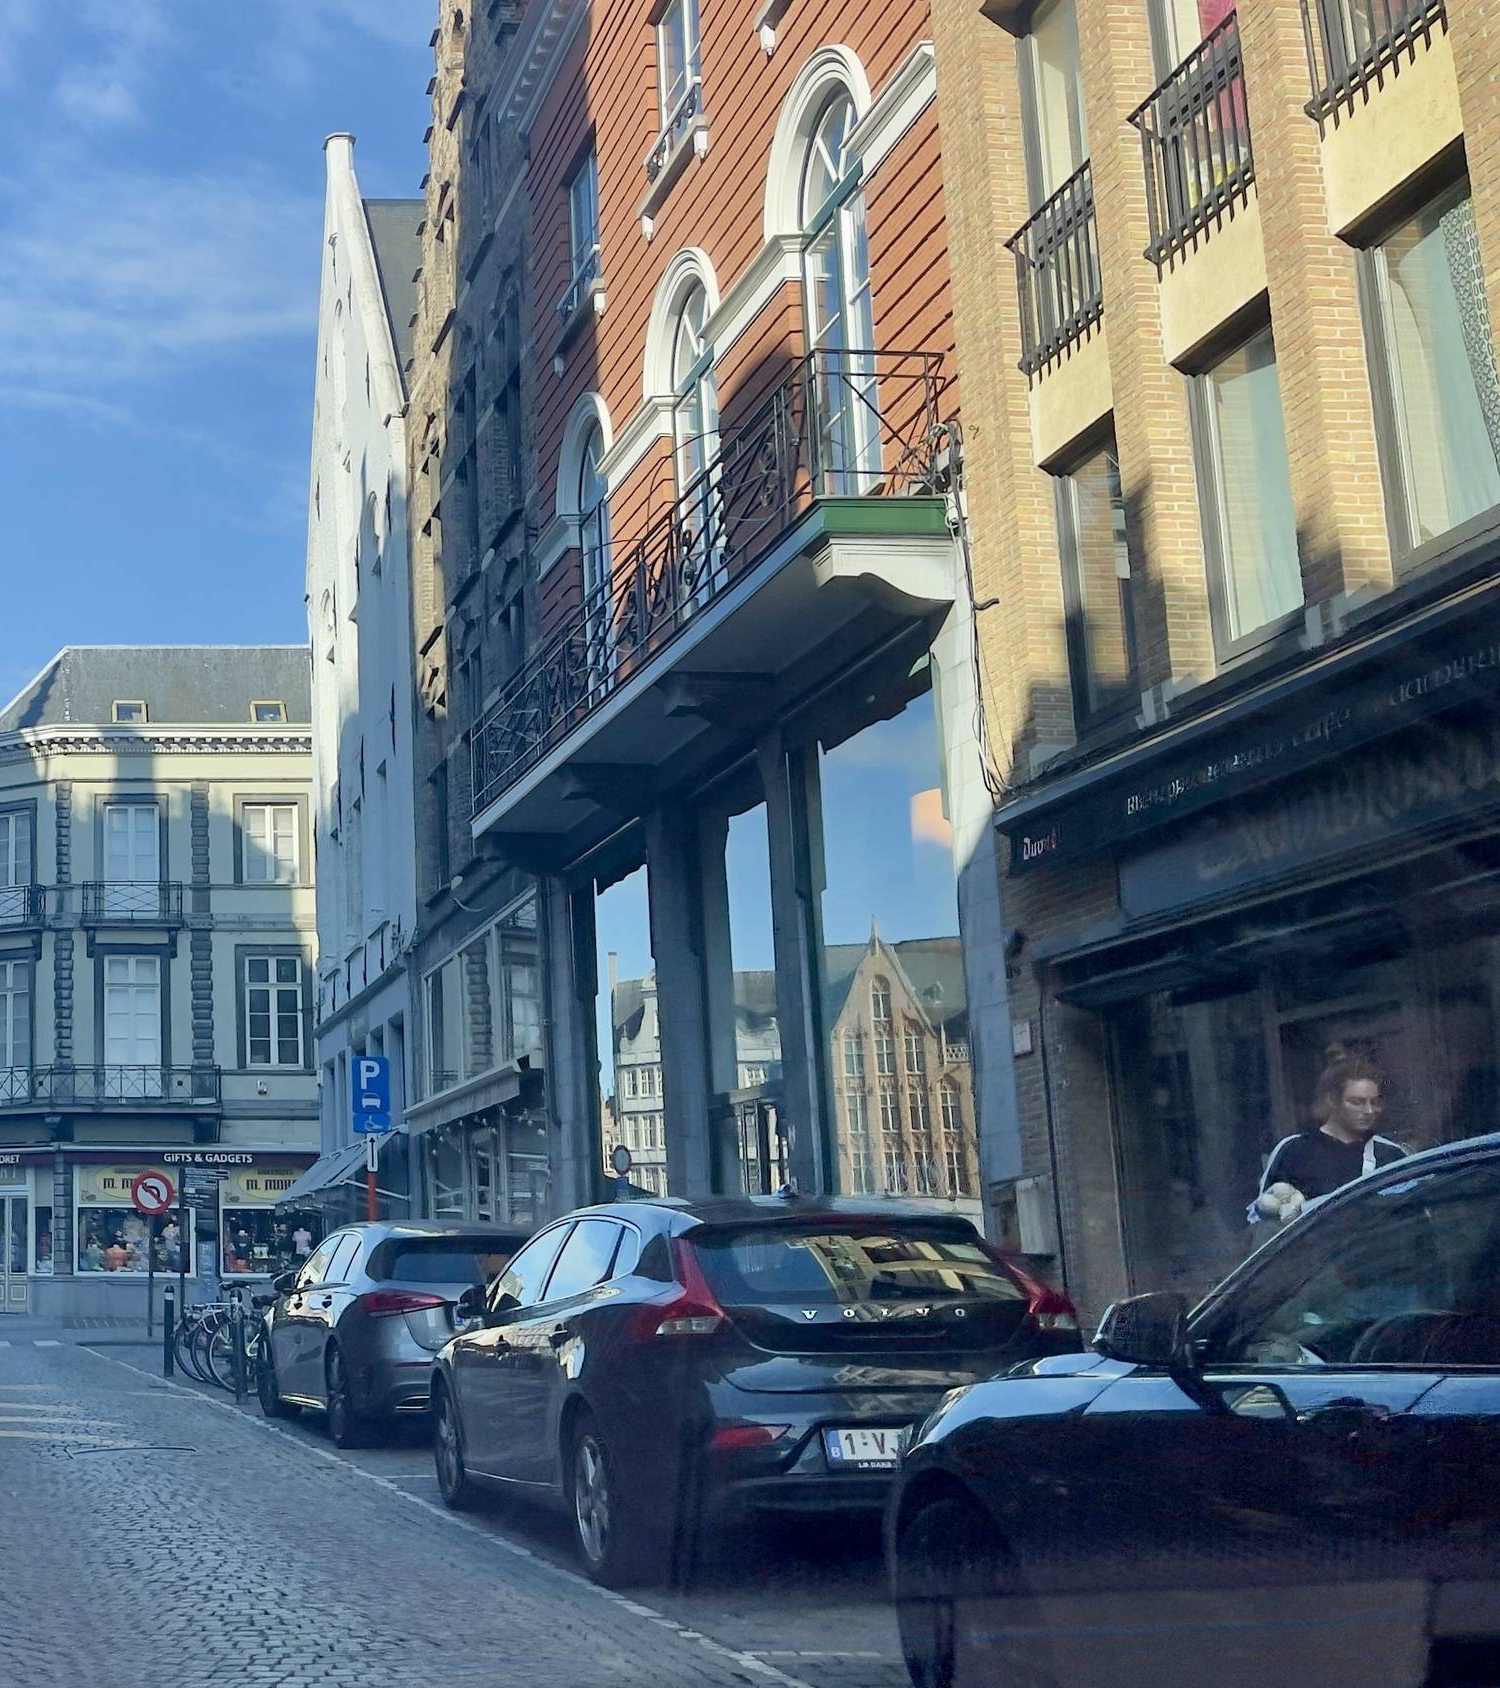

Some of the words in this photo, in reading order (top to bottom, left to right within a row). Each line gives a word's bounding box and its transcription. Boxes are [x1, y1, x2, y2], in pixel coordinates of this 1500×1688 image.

[360, 1060, 380, 1090] P
[163, 1153, 192, 1162] GIFTS
[194, 1153, 203, 1163] &
[205, 1153, 253, 1163] GADGETS
[801, 1308, 966, 1321] VOLVO
